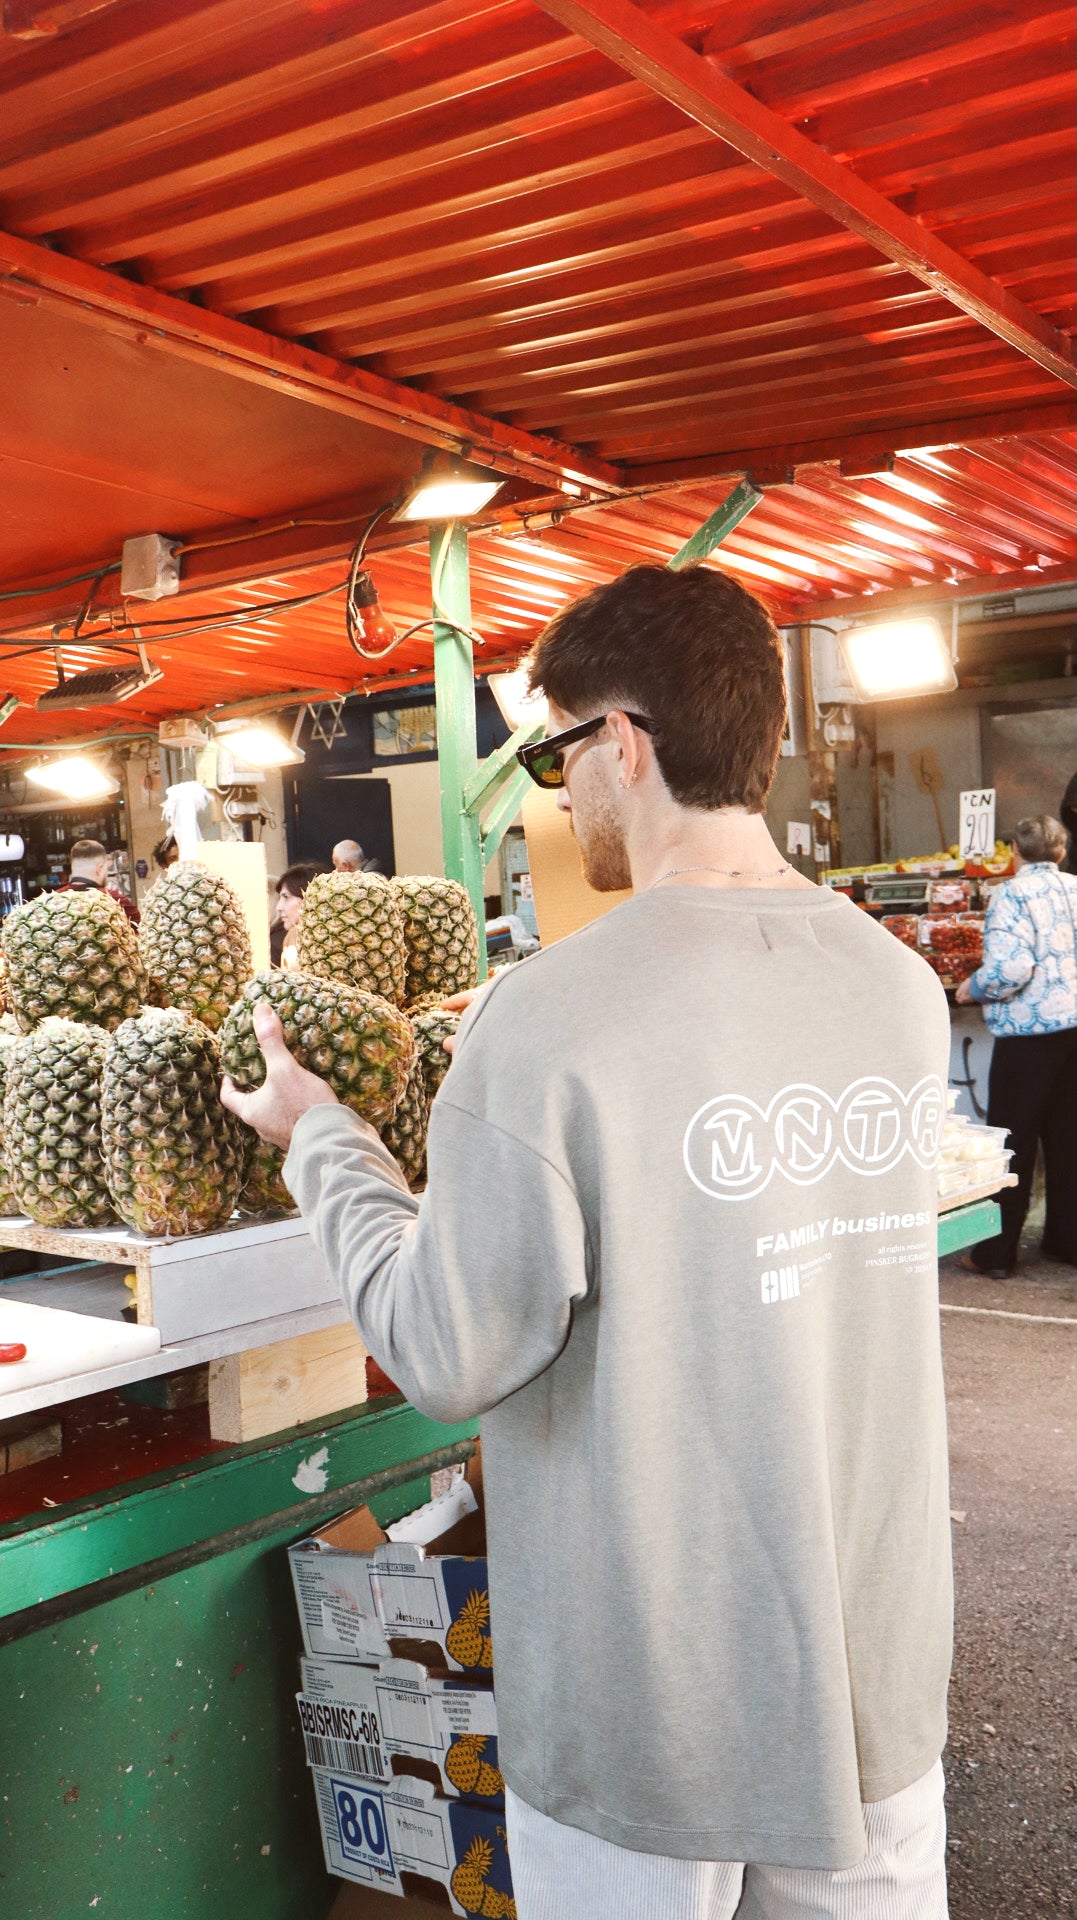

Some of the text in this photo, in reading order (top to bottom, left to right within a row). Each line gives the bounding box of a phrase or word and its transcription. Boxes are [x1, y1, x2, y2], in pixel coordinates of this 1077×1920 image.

[756, 1218, 830, 1257] FAMILY
[886, 1244, 906, 1253] rights
[865, 1255, 898, 1268] PINSKER
[337, 1790, 386, 1856] 80
